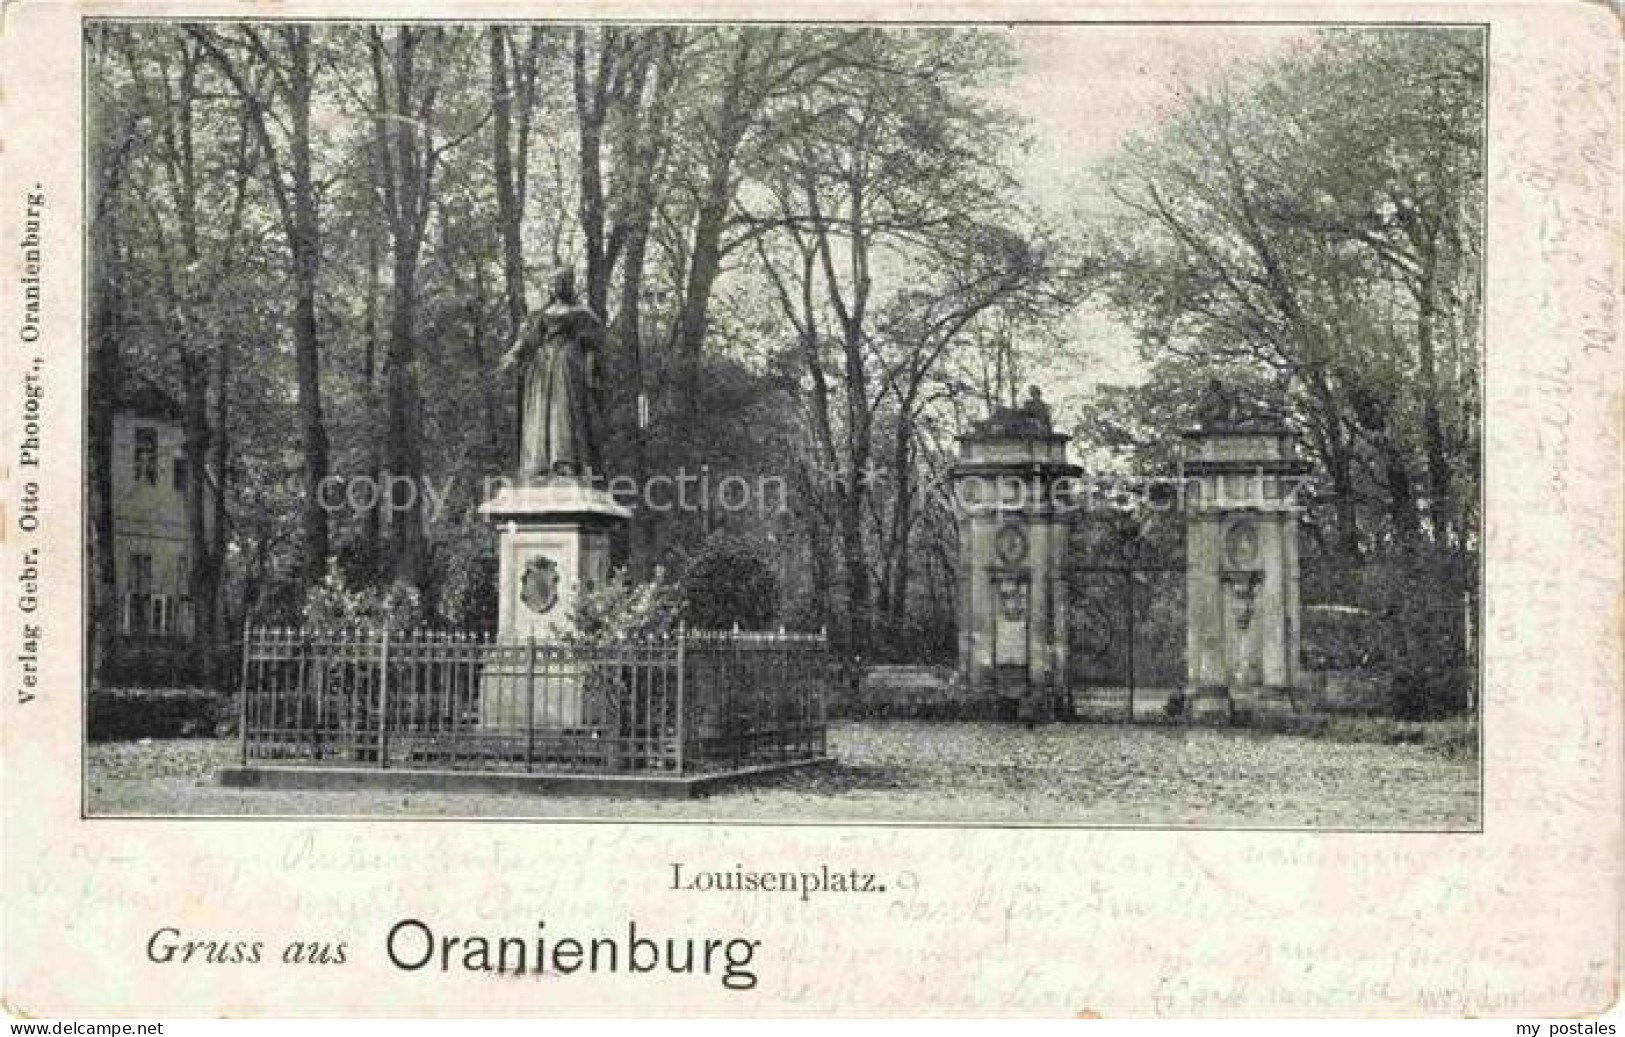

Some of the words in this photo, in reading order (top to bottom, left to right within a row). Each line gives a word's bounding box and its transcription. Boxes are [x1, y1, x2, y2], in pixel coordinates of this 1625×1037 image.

[20, 182, 46, 343] Oranienburg.
[19, 357, 43, 467] Photogr.,
[18, 482, 38, 532] Otto
[18, 549, 38, 614] Gebr.
[18, 624, 39, 704] Verlag
[670, 863, 887, 902] Louisenplatz.
[145, 928, 264, 965] Gruss
[282, 942, 348, 965] aus
[386, 918, 761, 991] Oranienburg
